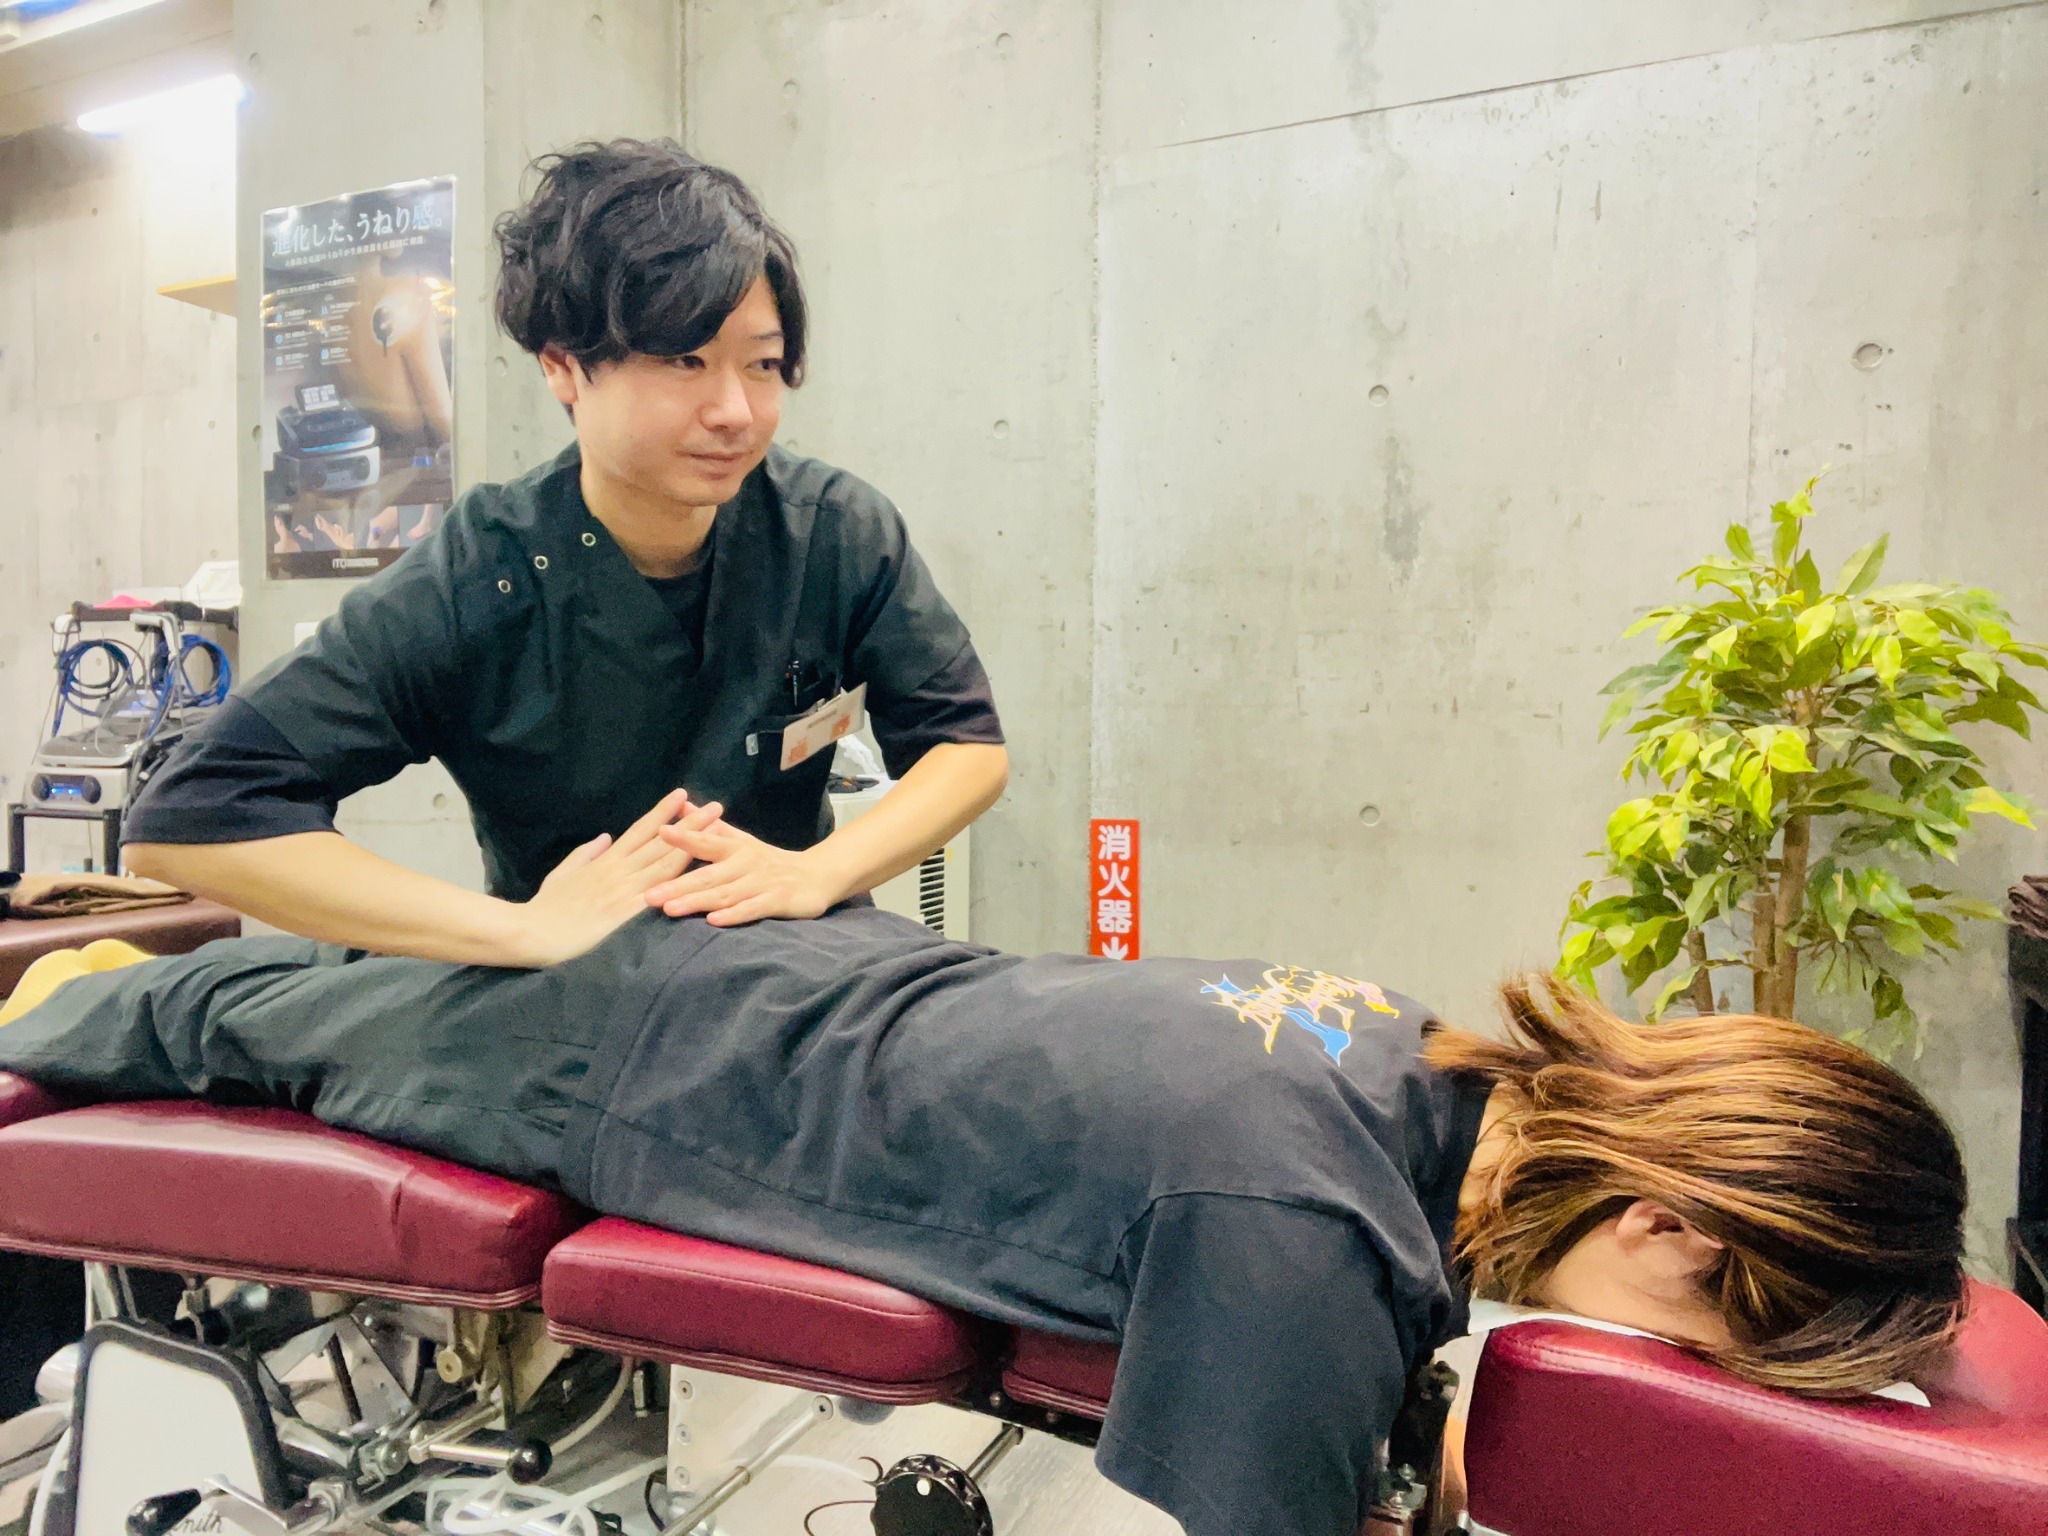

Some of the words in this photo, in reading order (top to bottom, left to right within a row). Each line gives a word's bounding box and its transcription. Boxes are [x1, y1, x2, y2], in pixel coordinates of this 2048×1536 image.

[272, 202, 442, 257] 進化した、うねり感。
[1097, 824, 1132, 934] 消火器
[171, 1510, 222, 1535] nith
